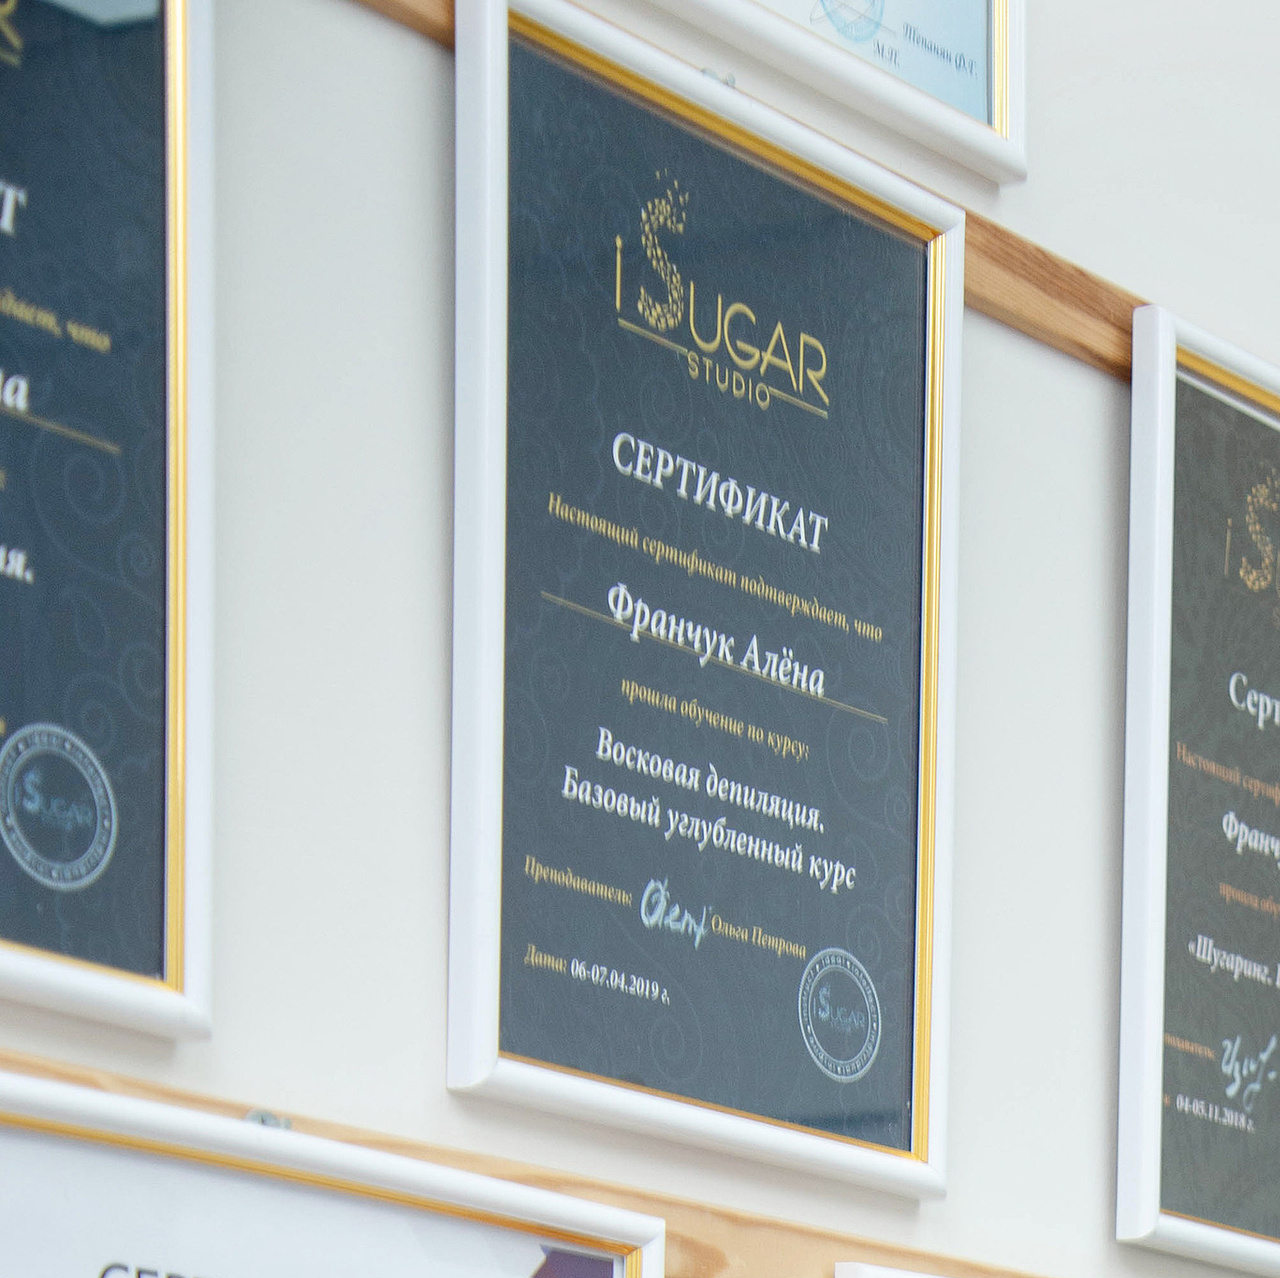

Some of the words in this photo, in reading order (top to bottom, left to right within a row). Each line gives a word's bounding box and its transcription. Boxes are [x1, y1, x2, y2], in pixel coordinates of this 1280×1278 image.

[687, 351, 770, 411] STUDIO
[612, 432, 828, 554] СЕРТИФИКАТ
[548, 492, 639, 549] Настоящий
[642, 535, 737, 586] сертификат
[741, 574, 849, 635] подтверждает,
[854, 618, 883, 643] что
[607, 582, 734, 667] Франчук
[740, 634, 825, 698] Алёна
[620, 678, 677, 714] прошла
[680, 698, 744, 735] обучение
[747, 721, 764, 743] по
[767, 730, 810, 763] курсу:
[596, 726, 700, 792] Восковая
[705, 763, 825, 834] депиляция.
[561, 765, 660, 828] Базовый
[664, 807, 803, 875] углубленный
[809, 852, 856, 894] курс
[525, 854, 633, 907] Преподаватель:
[524, 943, 567, 976] Дата:
[570, 957, 659, 1002] 06-07.04.2019
[711, 914, 749, 944] Ольга
[752, 926, 806, 960] Петрова
[1188, 934, 1273, 986] «Шугаринг.
